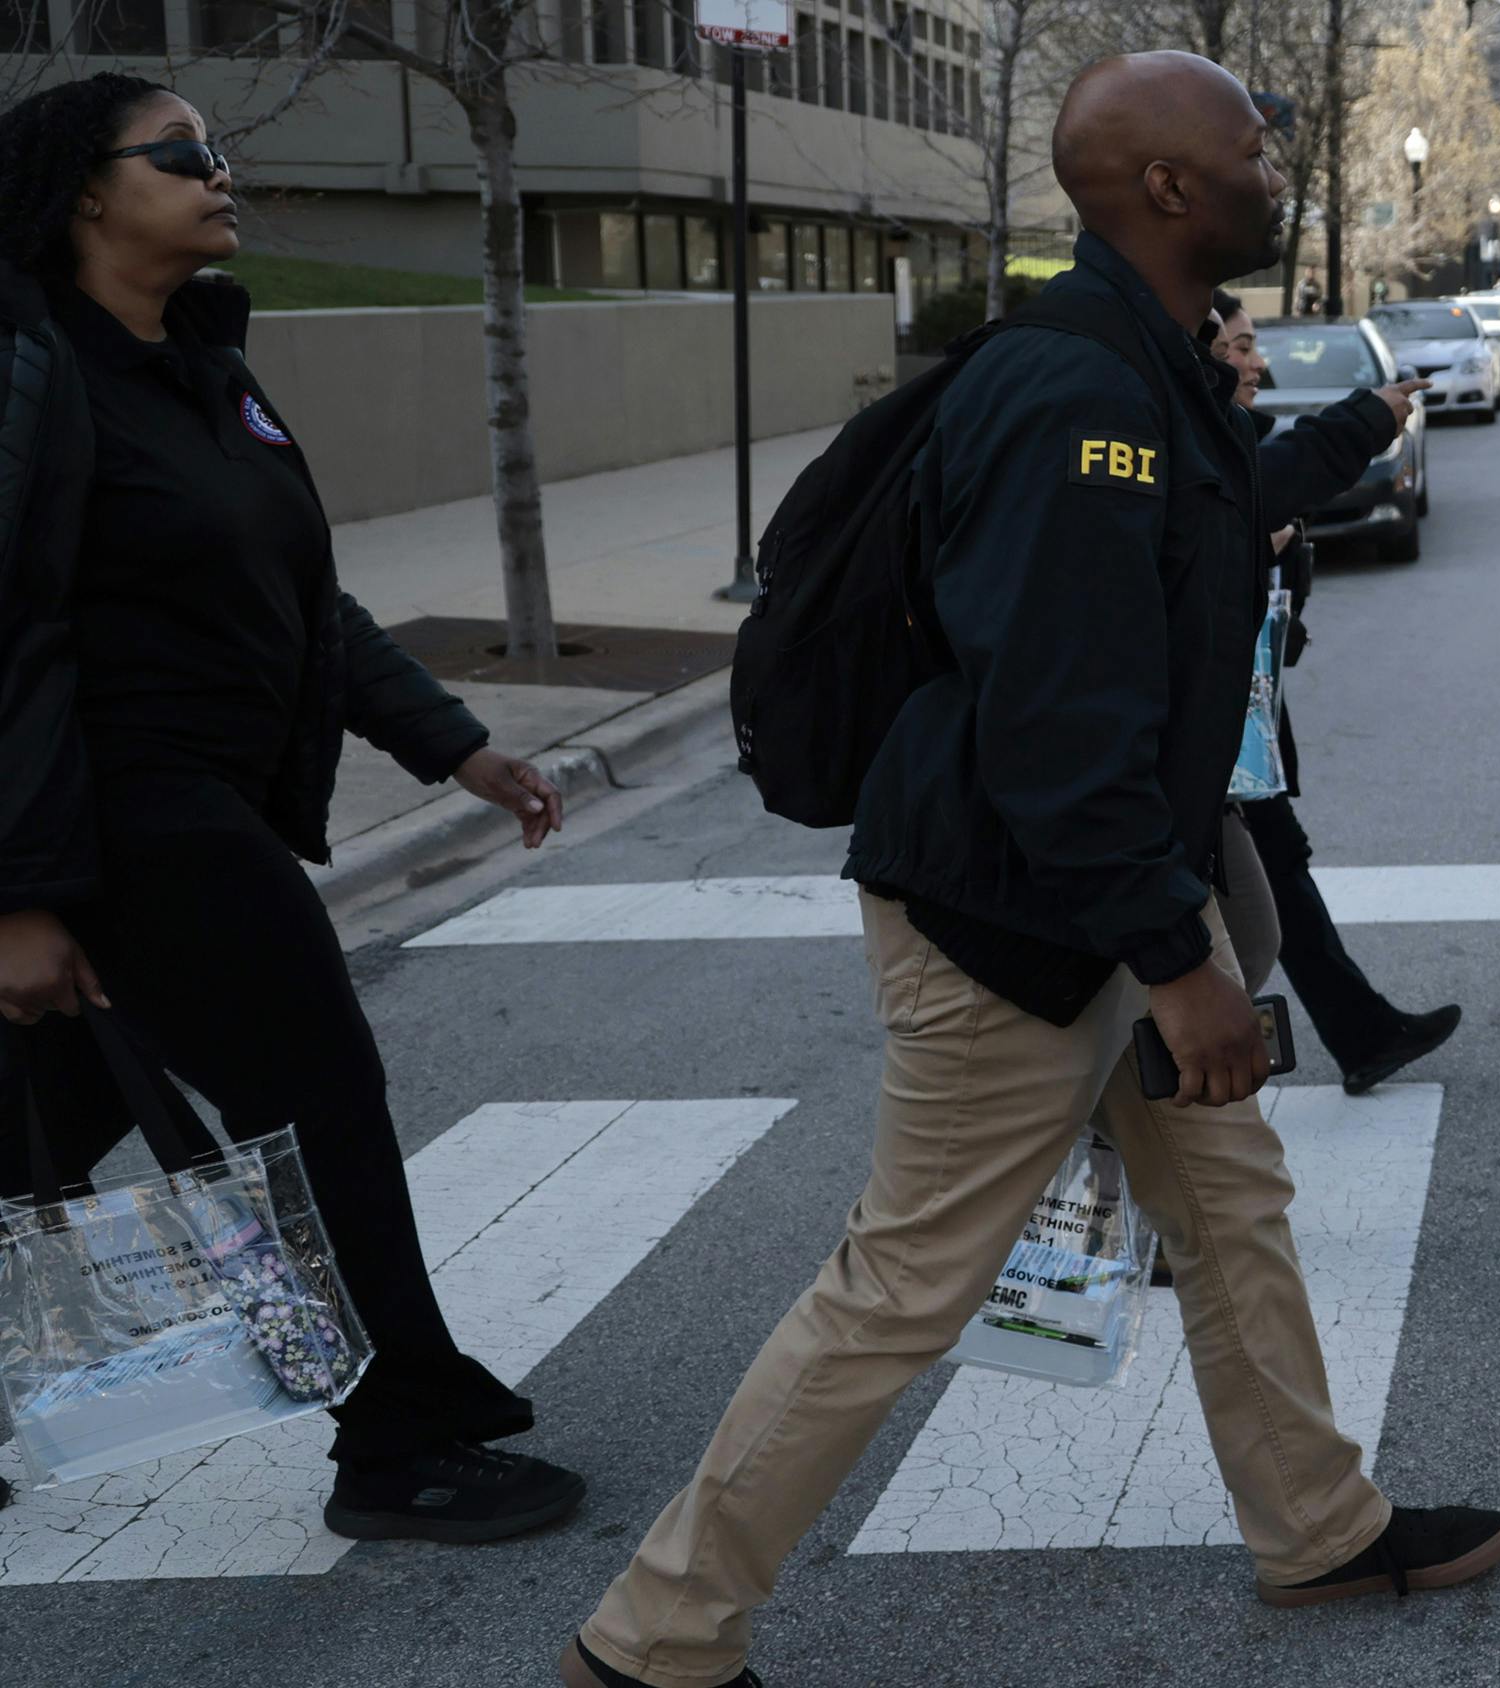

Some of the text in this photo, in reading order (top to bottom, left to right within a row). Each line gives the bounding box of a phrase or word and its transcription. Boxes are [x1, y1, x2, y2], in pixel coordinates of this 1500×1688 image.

[703, 26, 780, 47] TOW ZONE
[1081, 439, 1156, 484] FBI
[1029, 1213, 1086, 1234] ETHING
[1022, 1230, 1054, 1248] 9-1-1
